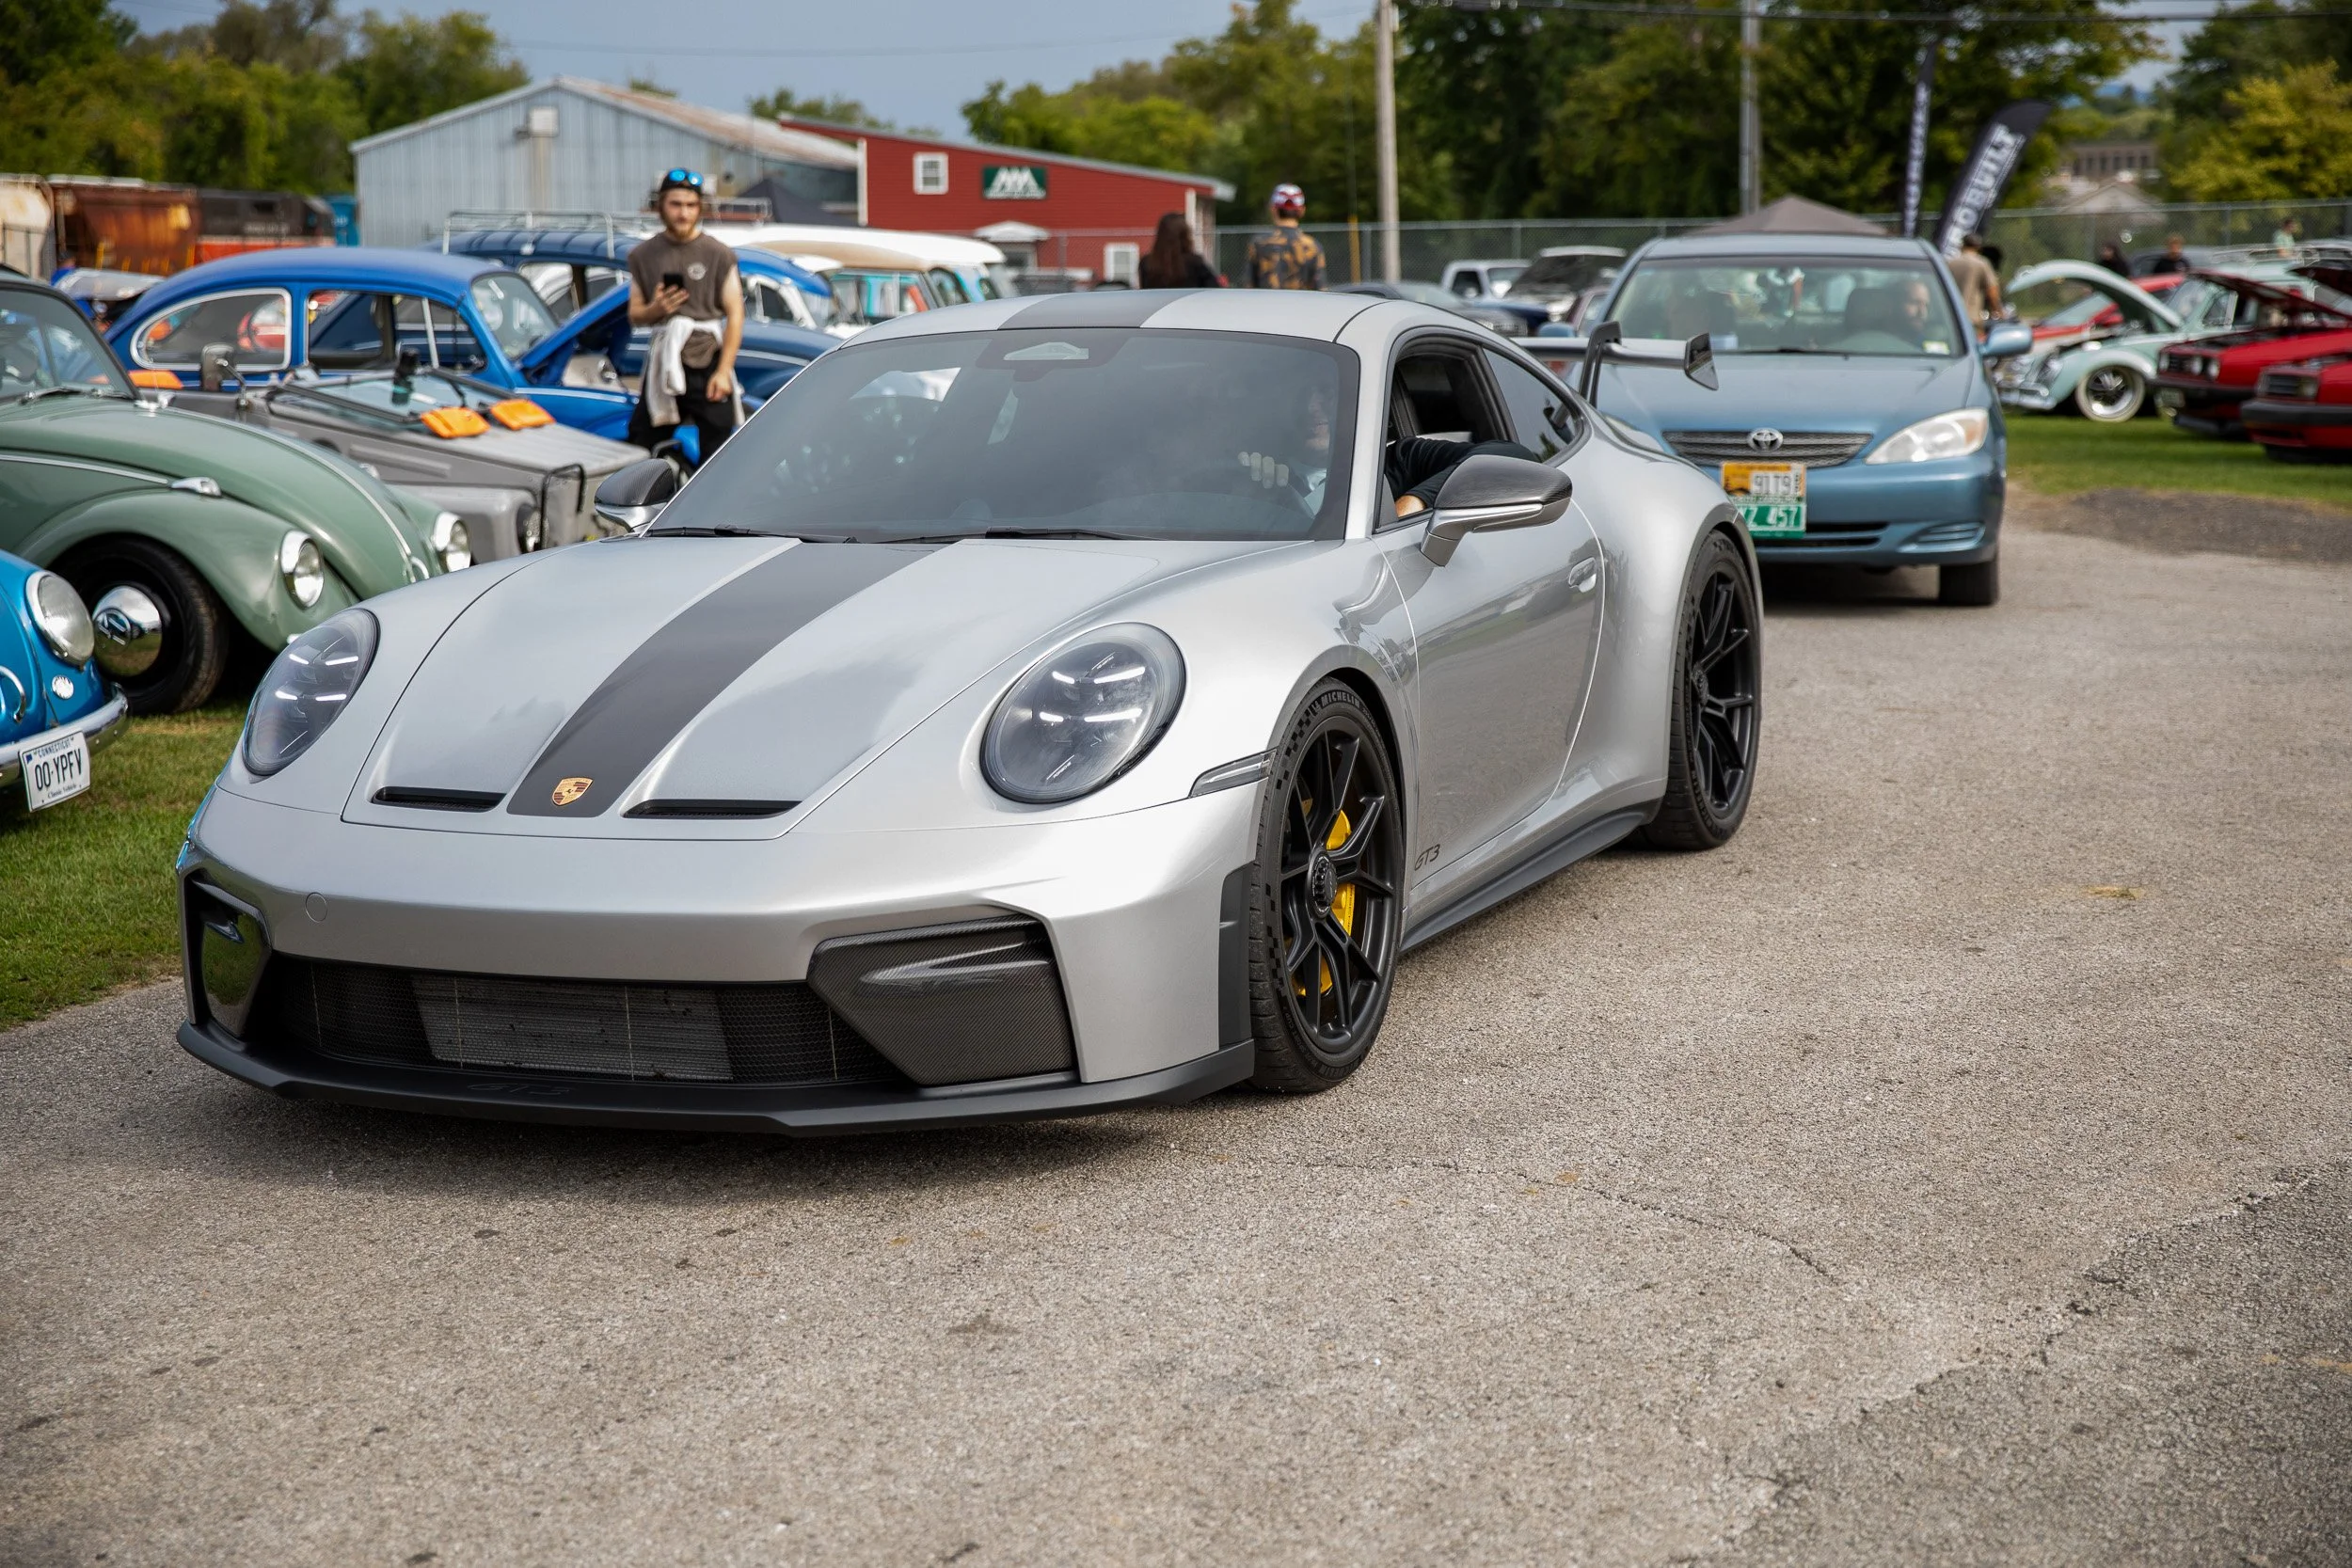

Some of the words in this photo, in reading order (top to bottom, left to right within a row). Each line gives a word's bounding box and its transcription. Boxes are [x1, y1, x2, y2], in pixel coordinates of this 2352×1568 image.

[1321, 691, 1359, 708] MICHELIN
[38, 739, 72, 758] CONNECTICUT
[1414, 844, 1440, 871] GT3
